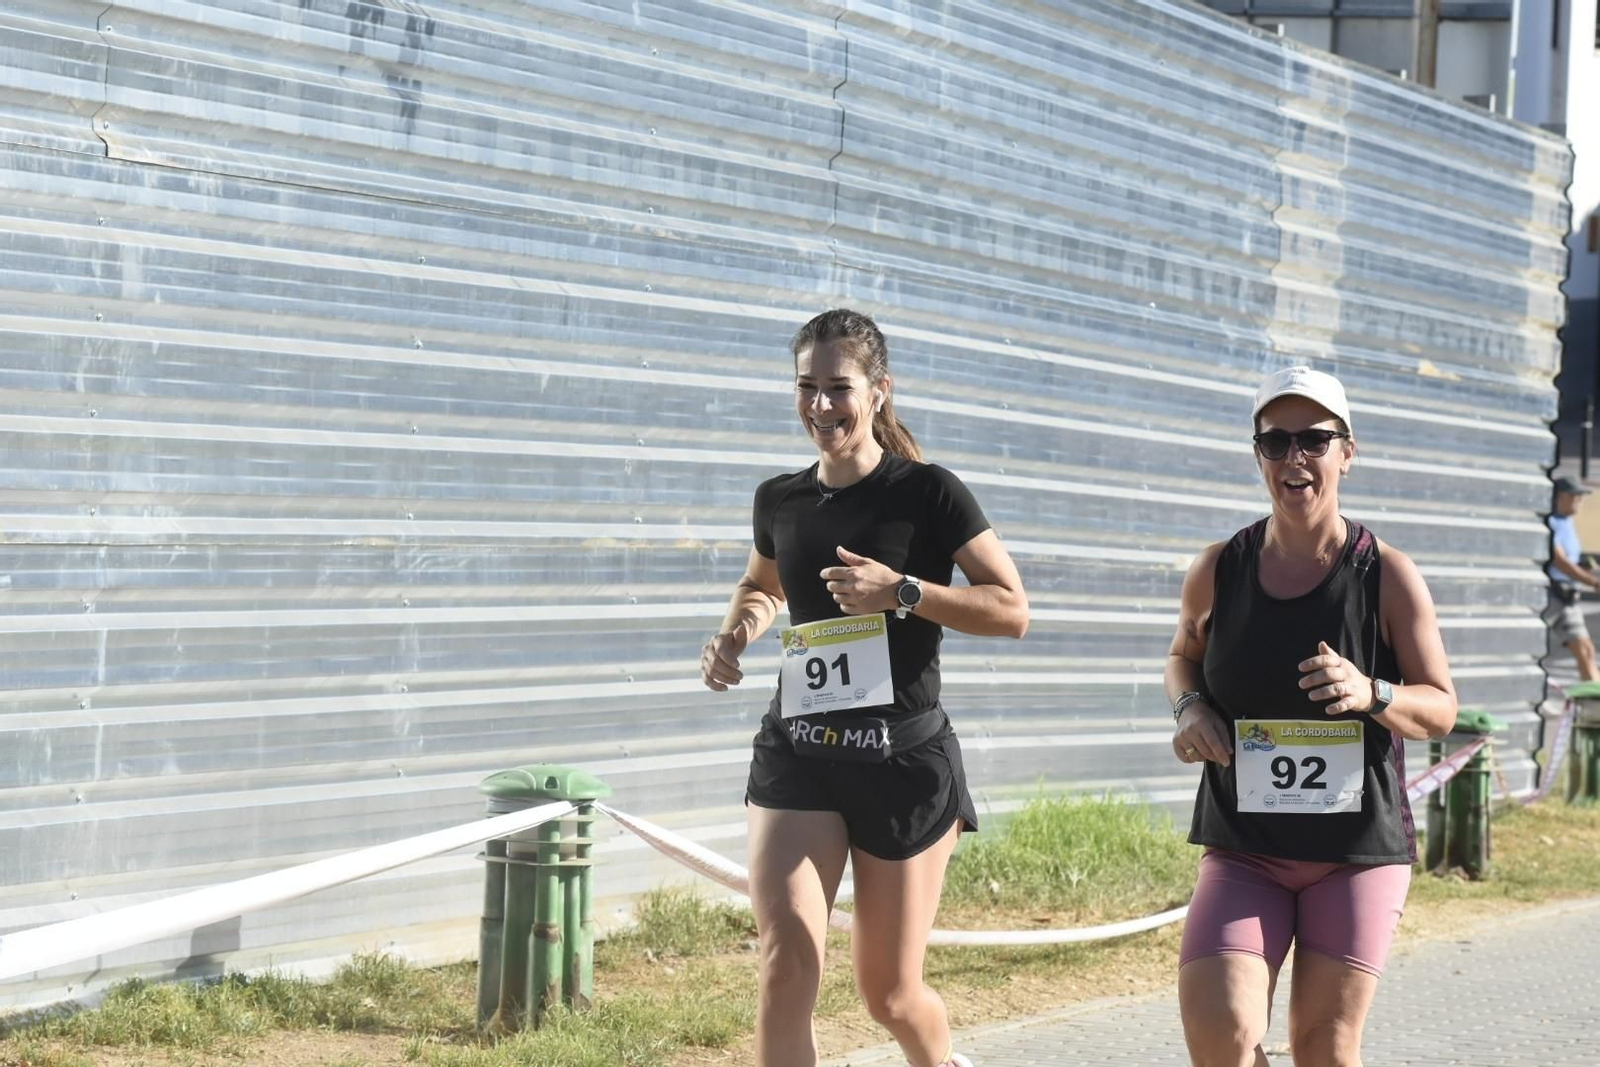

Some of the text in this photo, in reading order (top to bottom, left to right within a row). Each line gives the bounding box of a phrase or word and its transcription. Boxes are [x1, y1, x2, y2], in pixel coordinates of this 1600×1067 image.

[811, 628, 820, 638] LA
[805, 653, 851, 691] 91
[842, 727, 891, 749] MAX
[1281, 727, 1293, 737] LA
[1270, 756, 1327, 790] 92
